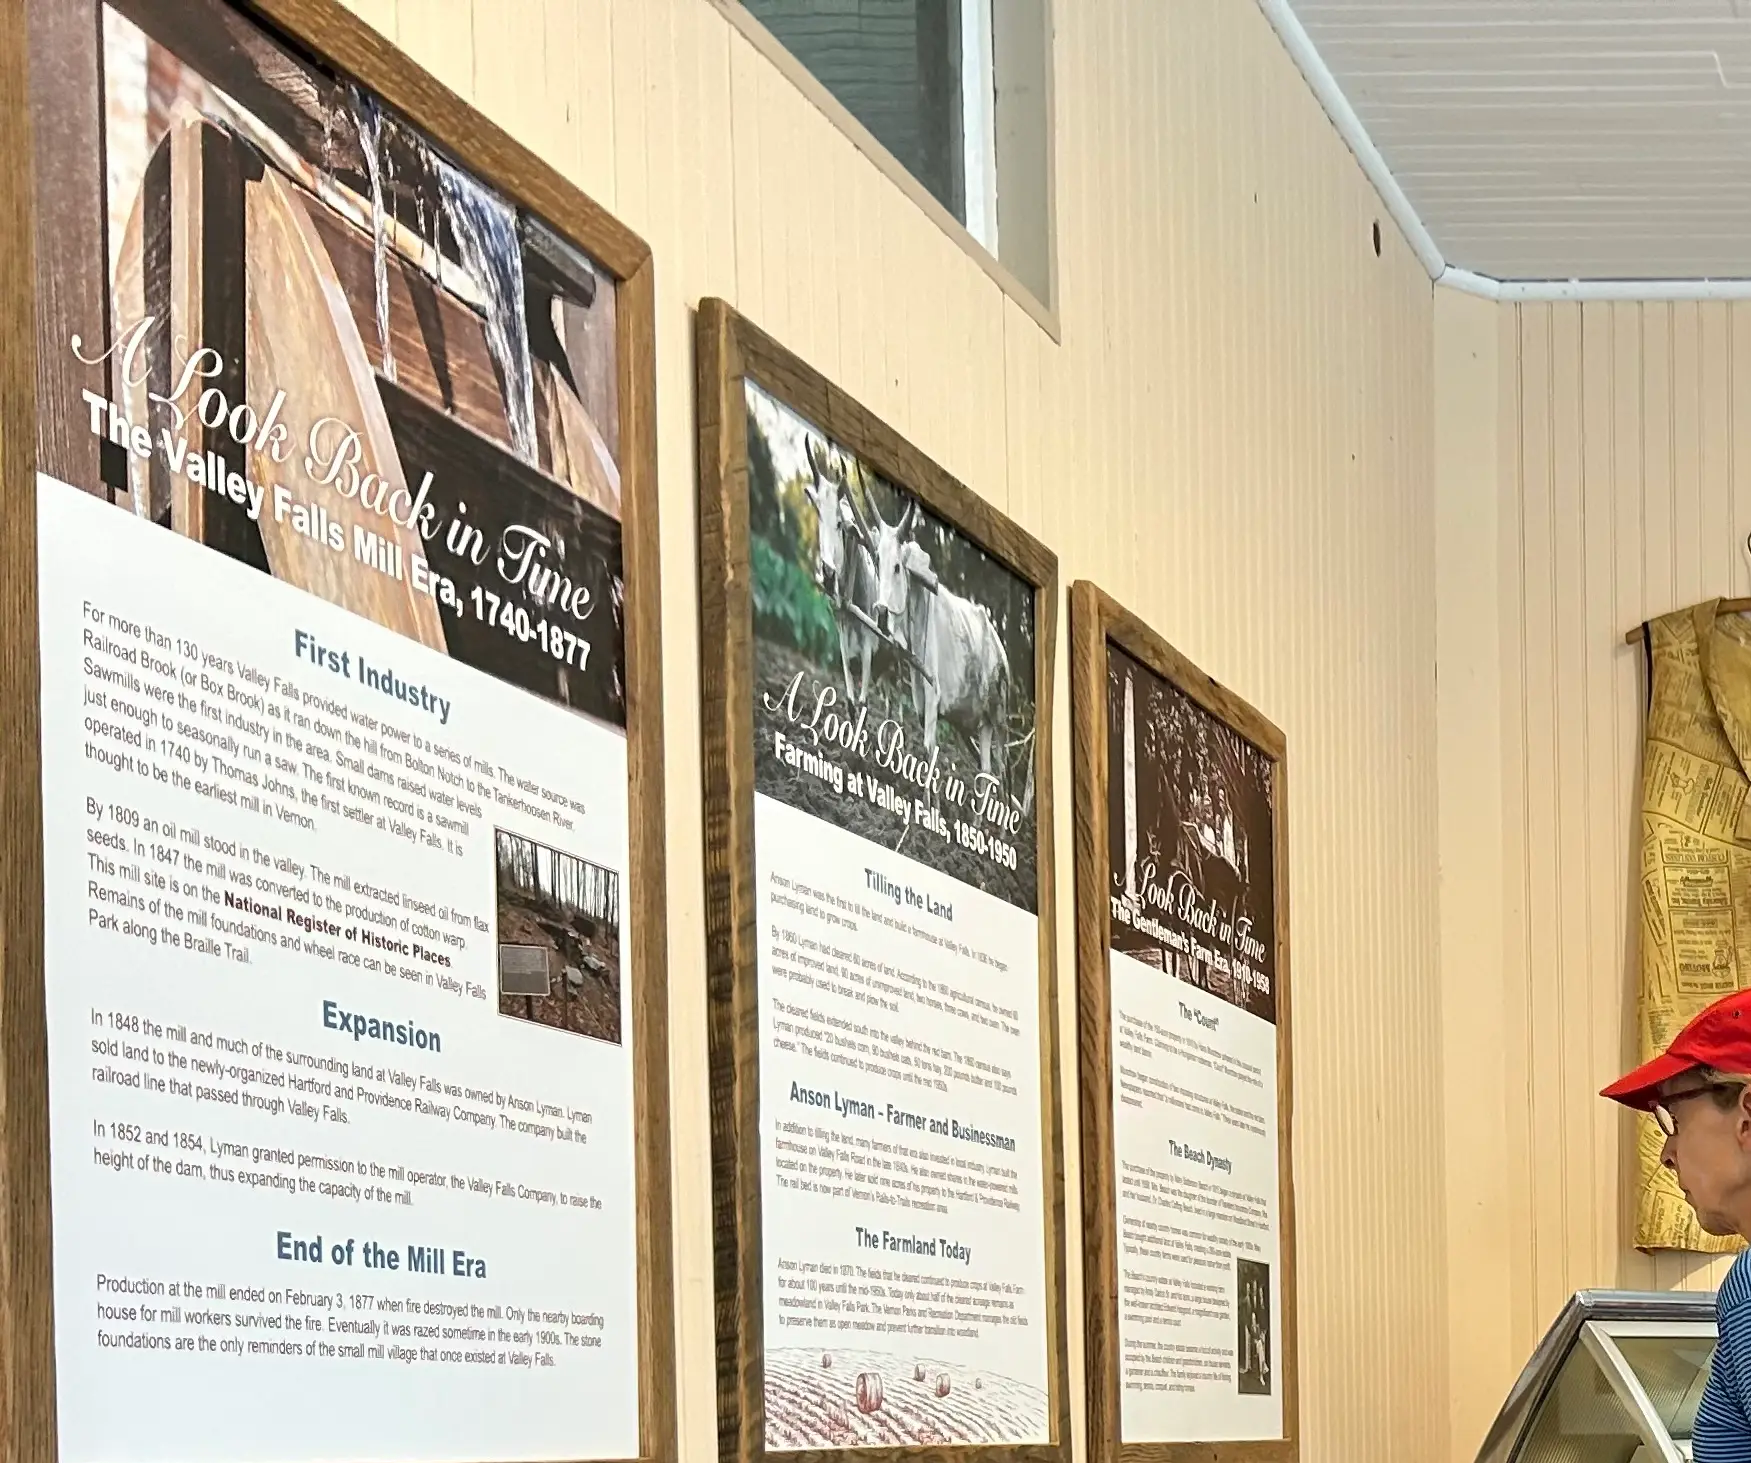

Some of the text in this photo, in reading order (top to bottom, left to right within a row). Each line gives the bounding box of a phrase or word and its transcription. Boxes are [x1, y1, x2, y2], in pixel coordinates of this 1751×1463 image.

[71, 316, 595, 620] A Look Back in Time
[82, 388, 591, 671] The Valley Falls Mill Era, 1740-1877
[295, 629, 451, 724] First Industry
[763, 671, 1023, 835] A Look Back in Time
[775, 731, 1017, 871] Farming at Valley Falls, 1850-1950
[88, 852, 454, 967] This mill site is on the National Register of Historic Places.
[864, 868, 901, 905] Tilling
[905, 886, 923, 909] the
[926, 894, 953, 922] Land
[1135, 862, 1175, 915] Look
[1178, 883, 1218, 938] Back
[1235, 916, 1267, 963] Time
[89, 908, 249, 963] Park along the Braille Trail.
[1111, 896, 1132, 925] The
[1190, 937, 1213, 965] Farm
[323, 1000, 441, 1053] Expansion
[1178, 1001, 1192, 1021] The
[92, 1066, 350, 1124] railroad line that passed through Valley Falls.
[790, 1081, 831, 1109] Anson
[835, 1091, 875, 1119] Lyman
[887, 1103, 927, 1131] Farmer
[929, 1118, 949, 1136] and
[952, 1119, 1015, 1152] Businessman
[1168, 1139, 1232, 1175] The Beach Dynasty
[277, 1231, 486, 1278] End of the Mill Era
[855, 1227, 971, 1264] The Farmland Today
